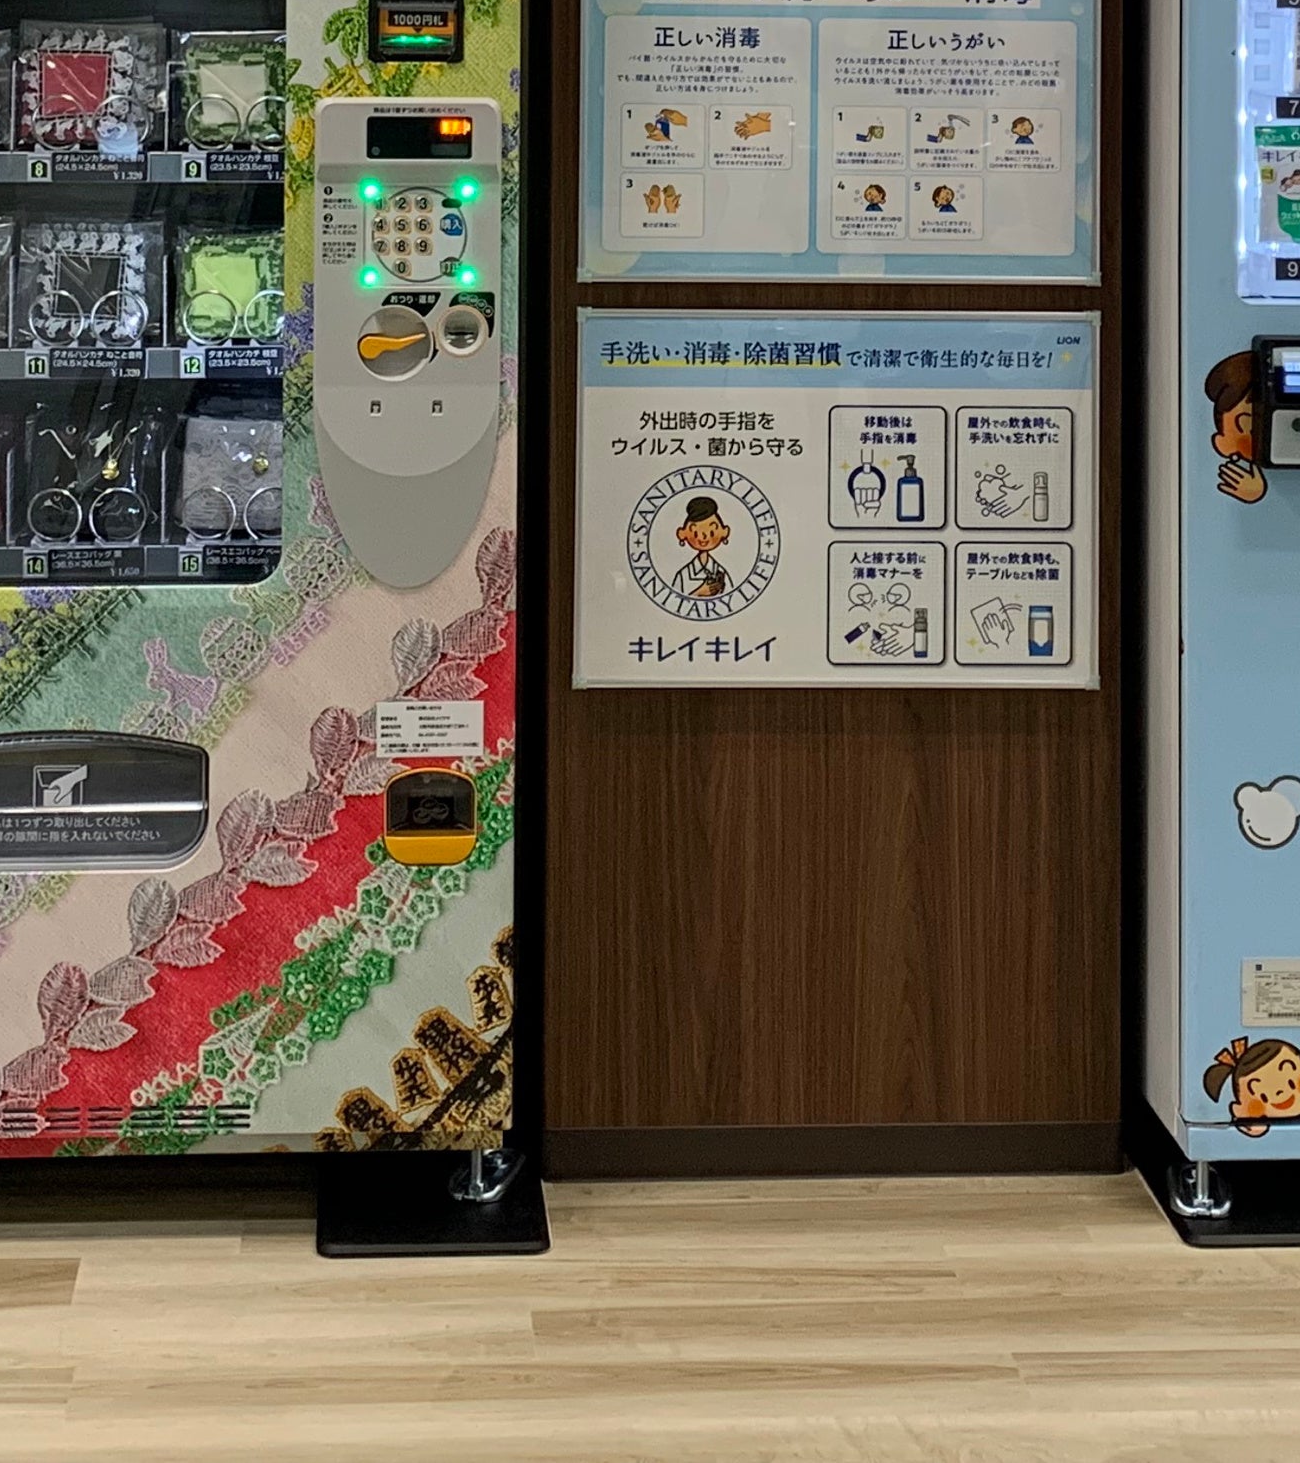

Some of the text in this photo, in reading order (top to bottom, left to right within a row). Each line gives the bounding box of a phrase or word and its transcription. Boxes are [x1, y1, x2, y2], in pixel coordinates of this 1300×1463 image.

[653, 25, 761, 49] 正しい消毒
[886, 28, 1006, 52] 正しいうがい
[1288, 100, 1299, 116] 7
[34, 162, 44, 178] 8
[188, 162, 198, 178] 9
[1286, 262, 1299, 278] 9
[1055, 336, 1081, 345] LION
[28, 358, 45, 376] 11
[183, 358, 201, 375] 12
[639, 410, 776, 431] 外出時の手指を
[863, 415, 913, 429] 移動後は
[967, 417, 1061, 430] 屋外での飲食時も、
[859, 432, 917, 445] 手指を消毒
[968, 432, 1059, 444] 手洗いを忘れずに
[610, 436, 805, 458] ウイルス・菌から守る
[631, 468, 743, 536] SANITARY
[27, 558, 44, 575] 14
[182, 557, 199, 574] 15
[849, 552, 927, 565] 人と接する前に
[966, 552, 1061, 566] 屋外での飲食時も、
[852, 568, 923, 581] 消毒マナーを
[965, 568, 1060, 581] テーブルなどを除菌
[627, 635, 777, 662] キレイキレイ
[129, 1062, 198, 1107] OKRA
